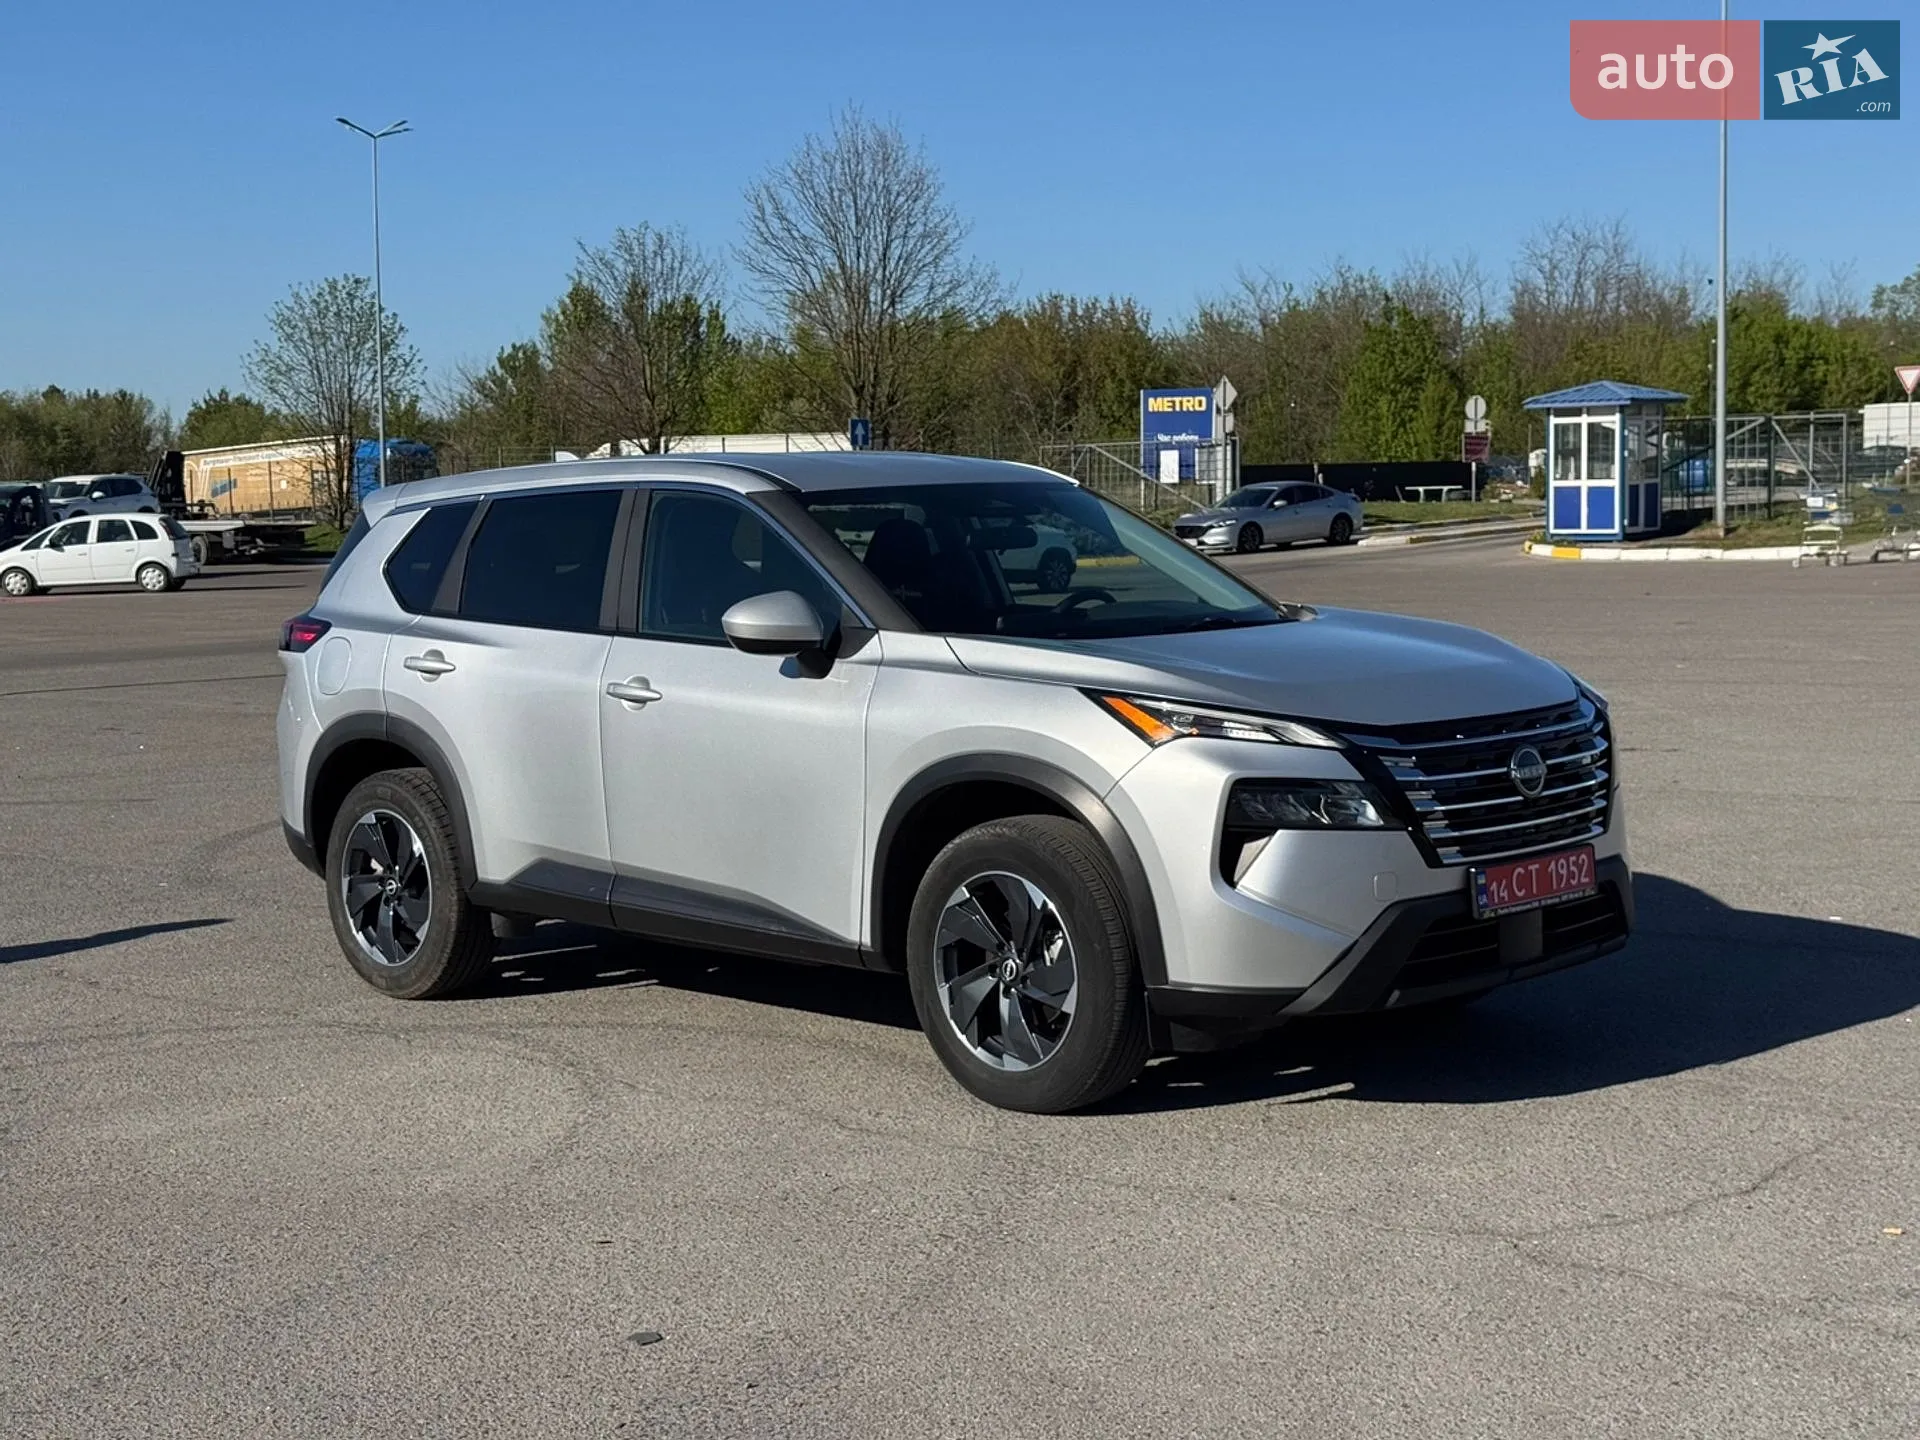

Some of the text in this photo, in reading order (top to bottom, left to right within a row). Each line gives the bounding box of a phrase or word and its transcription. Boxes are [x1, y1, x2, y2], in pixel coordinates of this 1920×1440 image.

[1148, 396, 1207, 412] METRO
[1489, 878, 1509, 904] 14
[1512, 863, 1540, 897] CT
[1548, 853, 1590, 891] 1952
